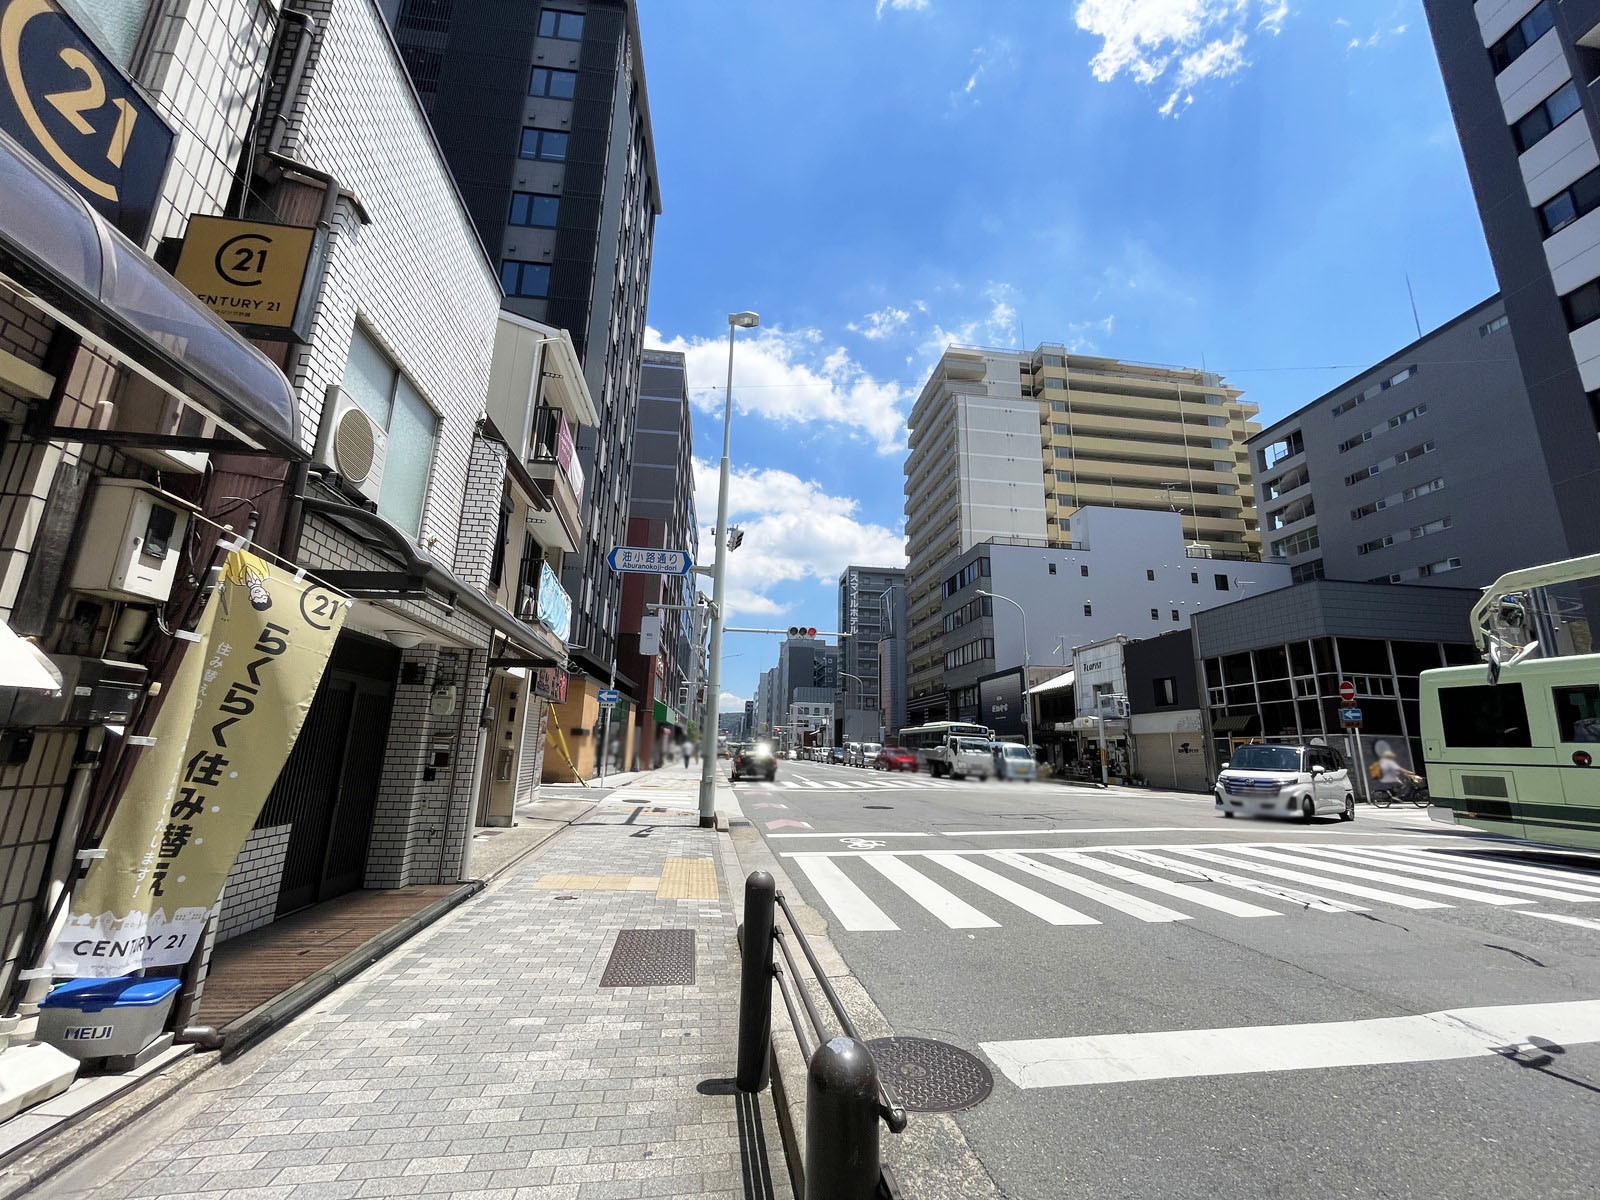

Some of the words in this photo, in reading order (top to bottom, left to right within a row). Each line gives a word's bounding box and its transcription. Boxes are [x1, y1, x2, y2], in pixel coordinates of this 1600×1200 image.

[197, 294, 263, 310] ENTURY
[267, 302, 280, 312] 21
[622, 551, 678, 565] 油小路通り
[622, 562, 677, 572] Aburanokoji-dori
[850, 574, 859, 635] スマイルホテル
[1083, 662, 1102, 672] FLORIST
[164, 934, 187, 949] 21
[64, 1026, 113, 1040] MEIJI
